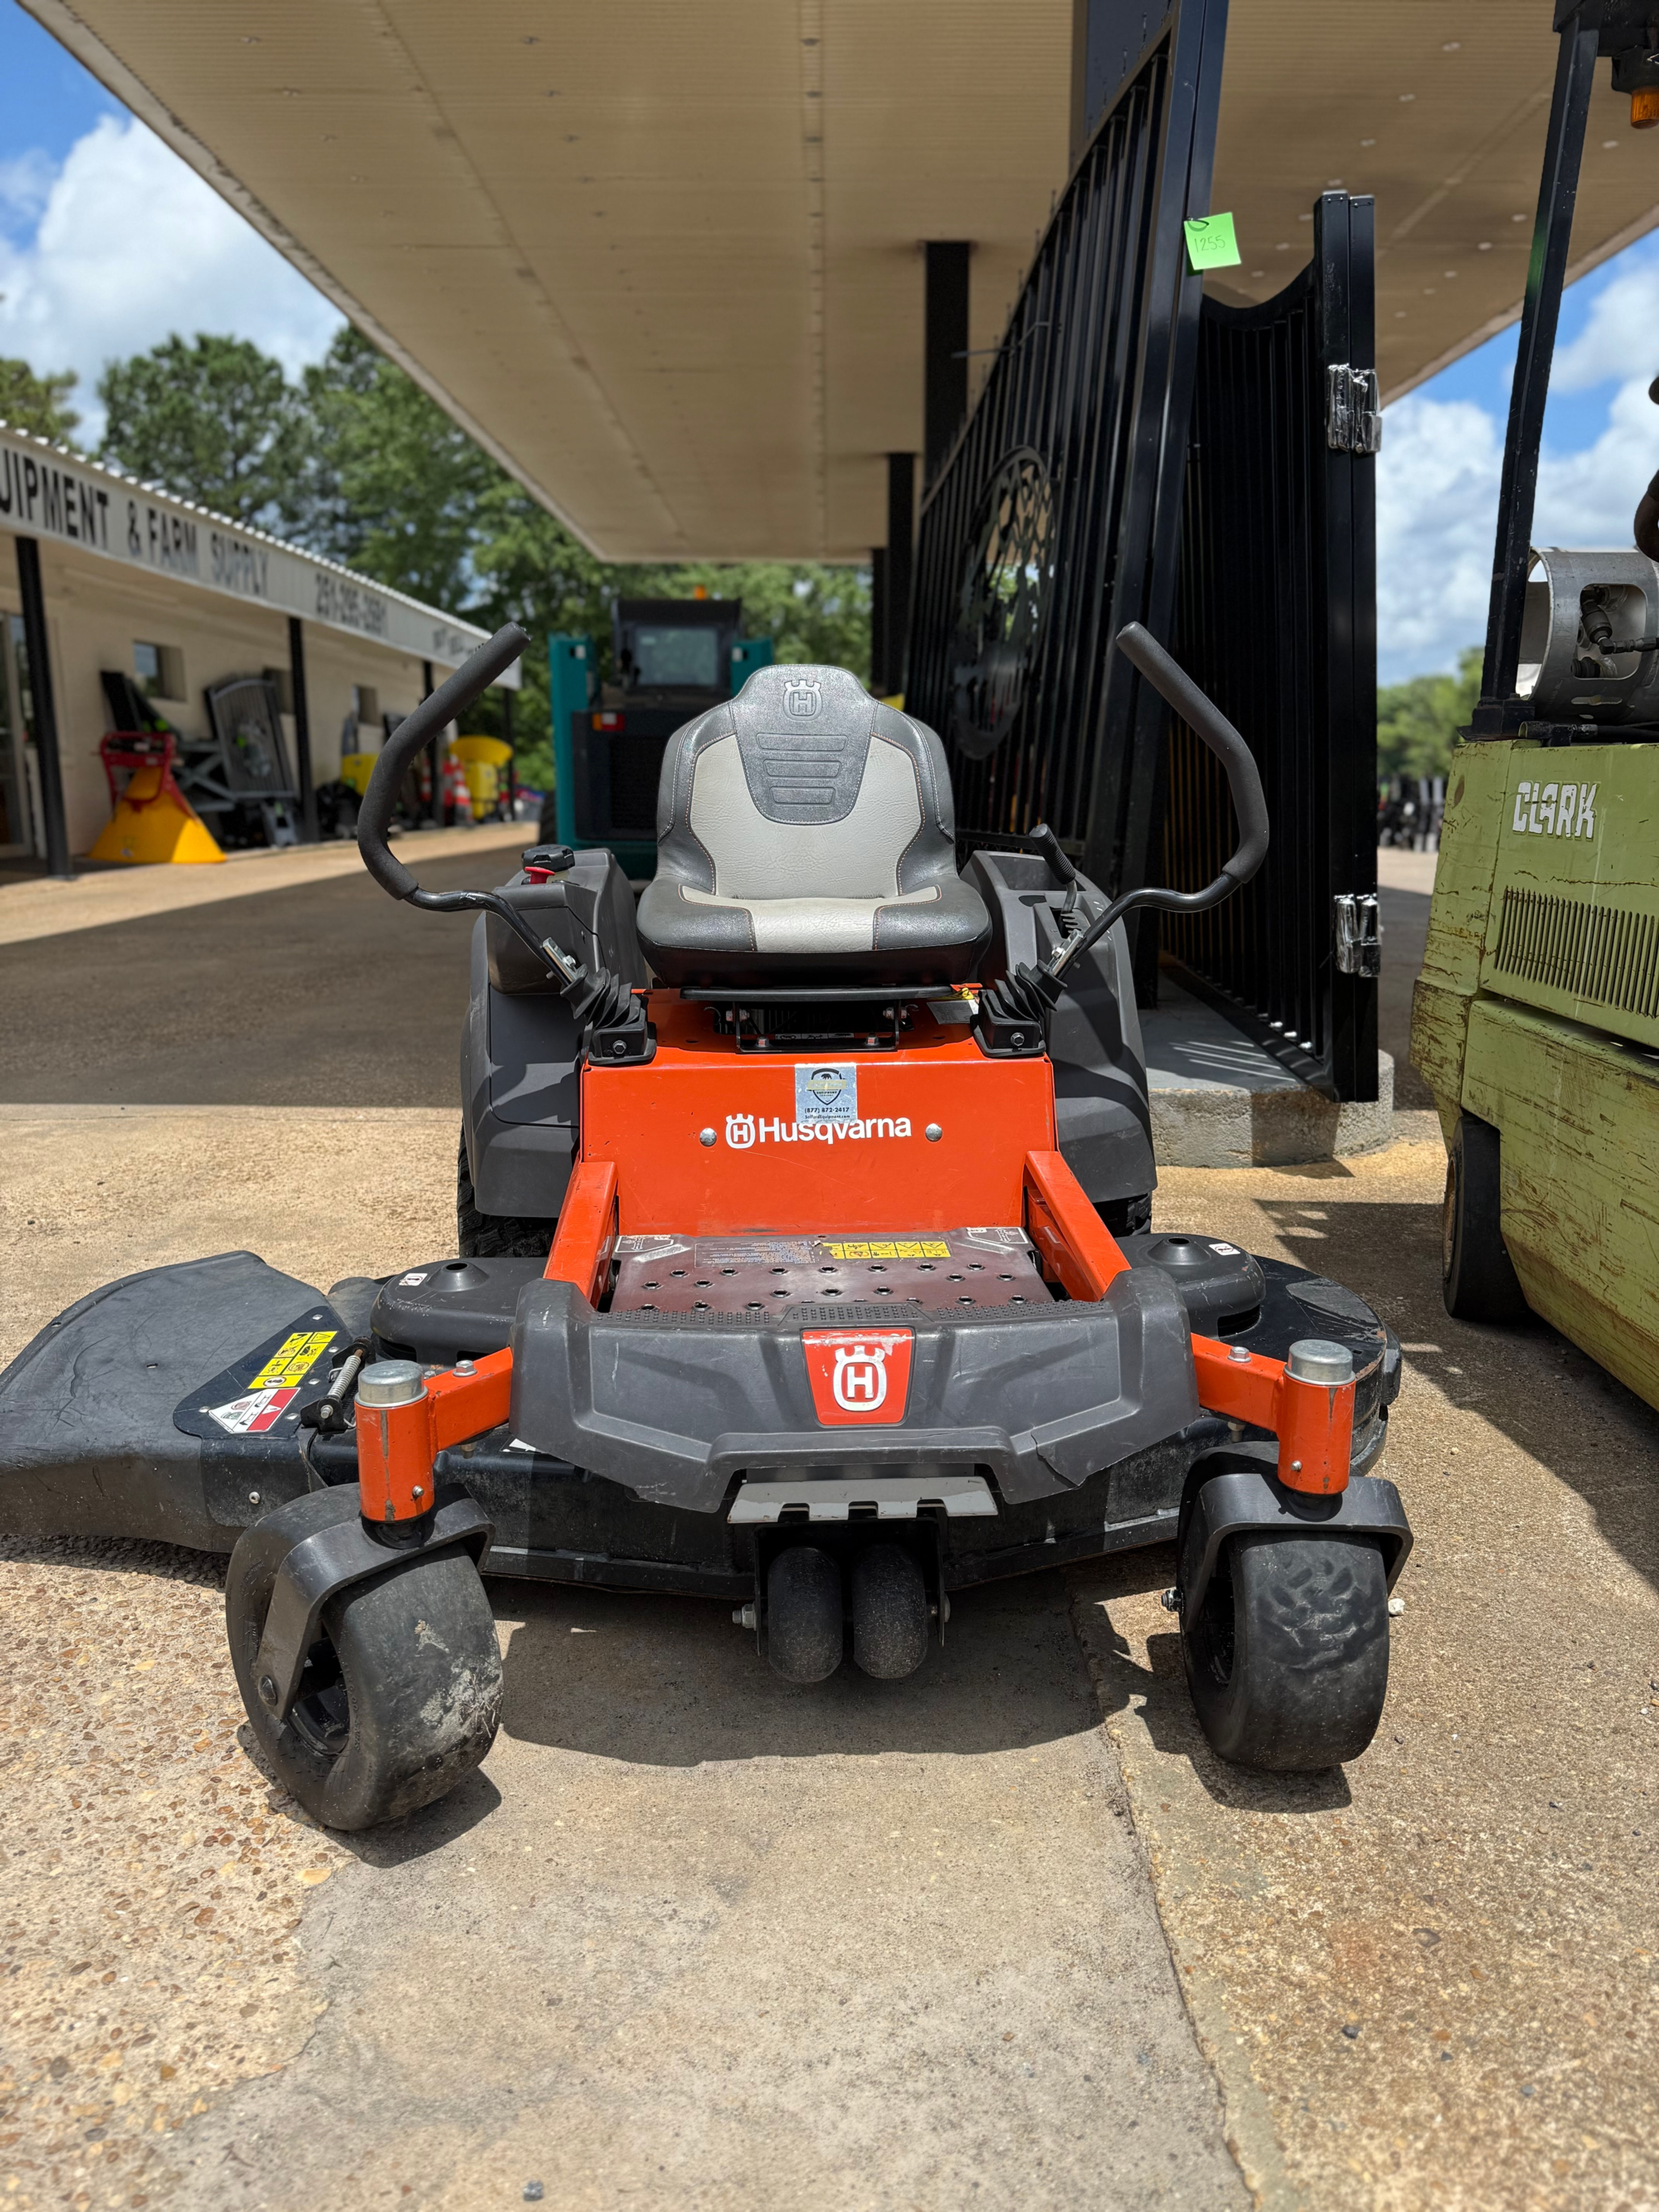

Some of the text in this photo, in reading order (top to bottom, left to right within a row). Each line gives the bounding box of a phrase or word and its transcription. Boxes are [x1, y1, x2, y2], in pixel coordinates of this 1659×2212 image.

[1194, 235, 1225, 252] 1255
[127, 500, 141, 557] &
[148, 507, 199, 571] FARM
[211, 532, 268, 596] SUPPLY
[1512, 781, 1599, 839] CLARK
[759, 1117, 912, 1145] Husqvarna
